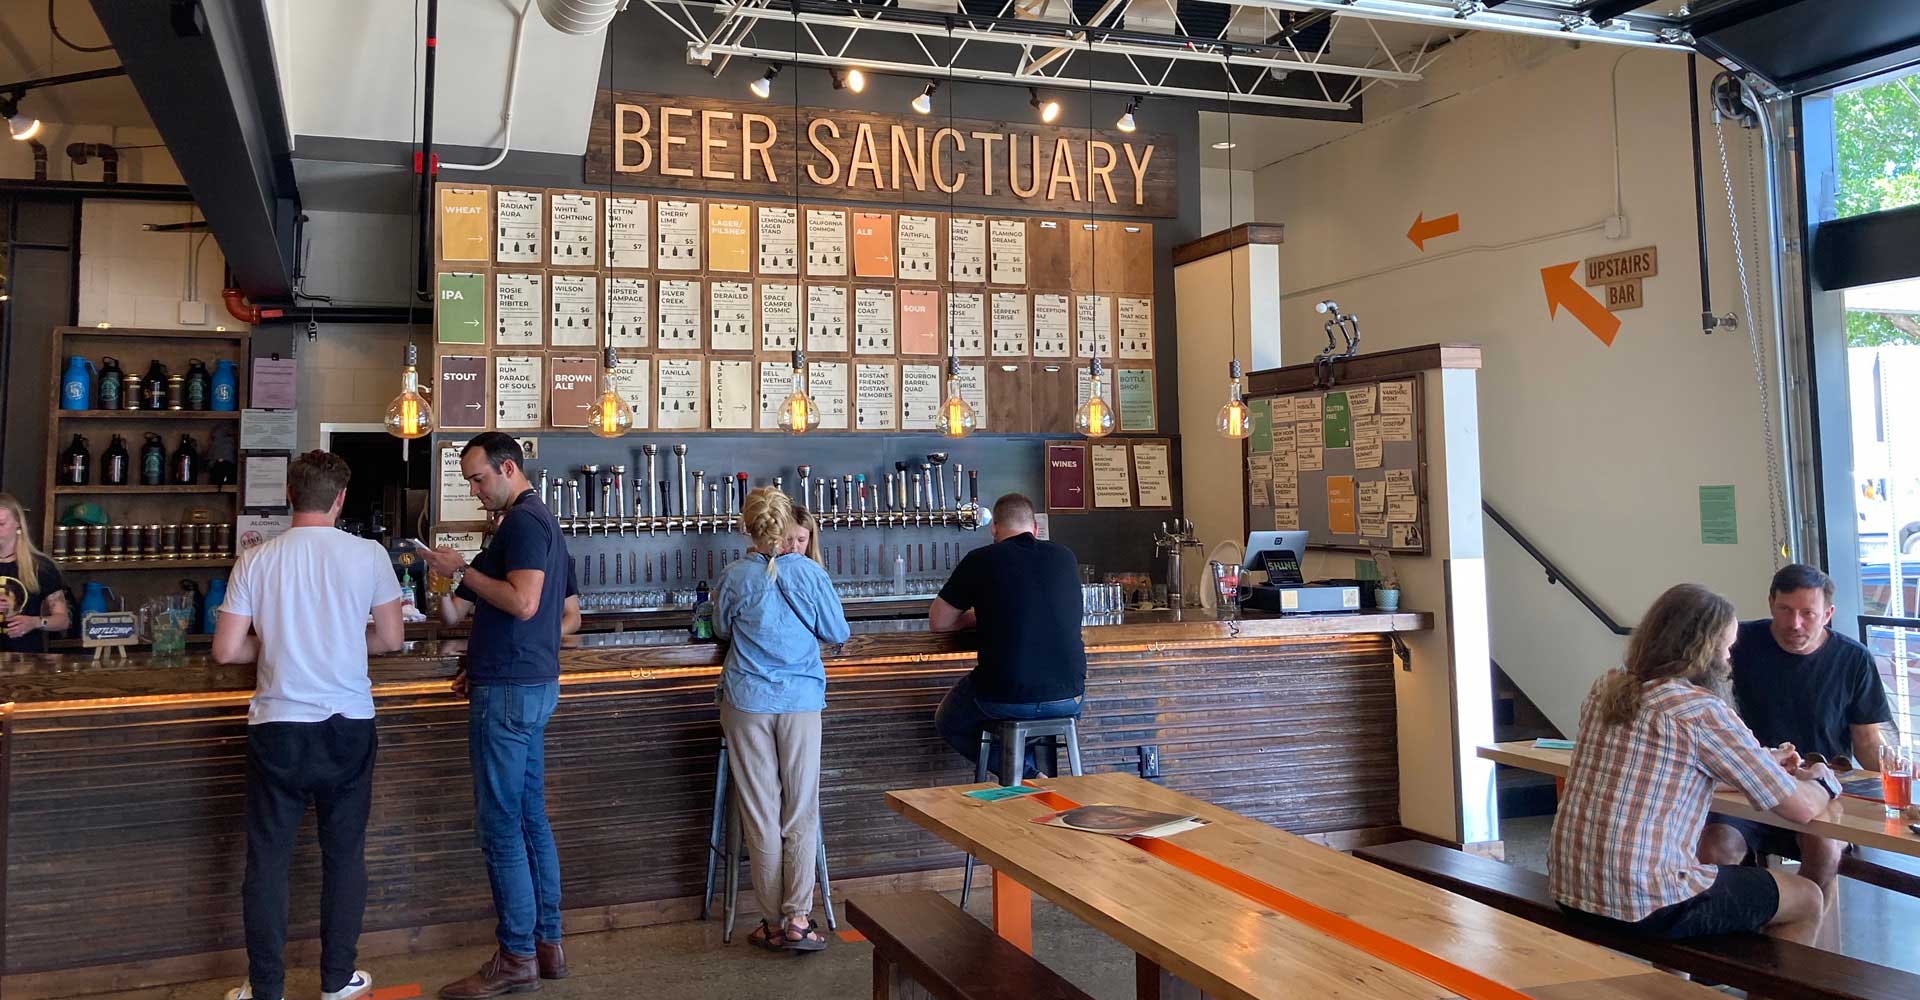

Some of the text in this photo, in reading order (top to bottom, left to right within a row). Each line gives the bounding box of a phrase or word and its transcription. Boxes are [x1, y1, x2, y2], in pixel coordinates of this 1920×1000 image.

[614, 103, 1155, 205] BEER SANCTUARY
[444, 206, 481, 214] WHEAT
[500, 202, 534, 210] RADIANT
[500, 210, 521, 218] AURA
[554, 213, 593, 222] LIGHTNING
[712, 219, 743, 227] LAGER/
[712, 227, 746, 235] PILSNER
[1589, 253, 1650, 281] UPSTAIRS
[441, 290, 464, 300] IPA
[1610, 284, 1635, 305] BAR
[903, 305, 926, 313] SOUR
[443, 373, 477, 381] STOUT
[1052, 460, 1077, 468] WINES
[1268, 561, 1298, 571] SHINE
